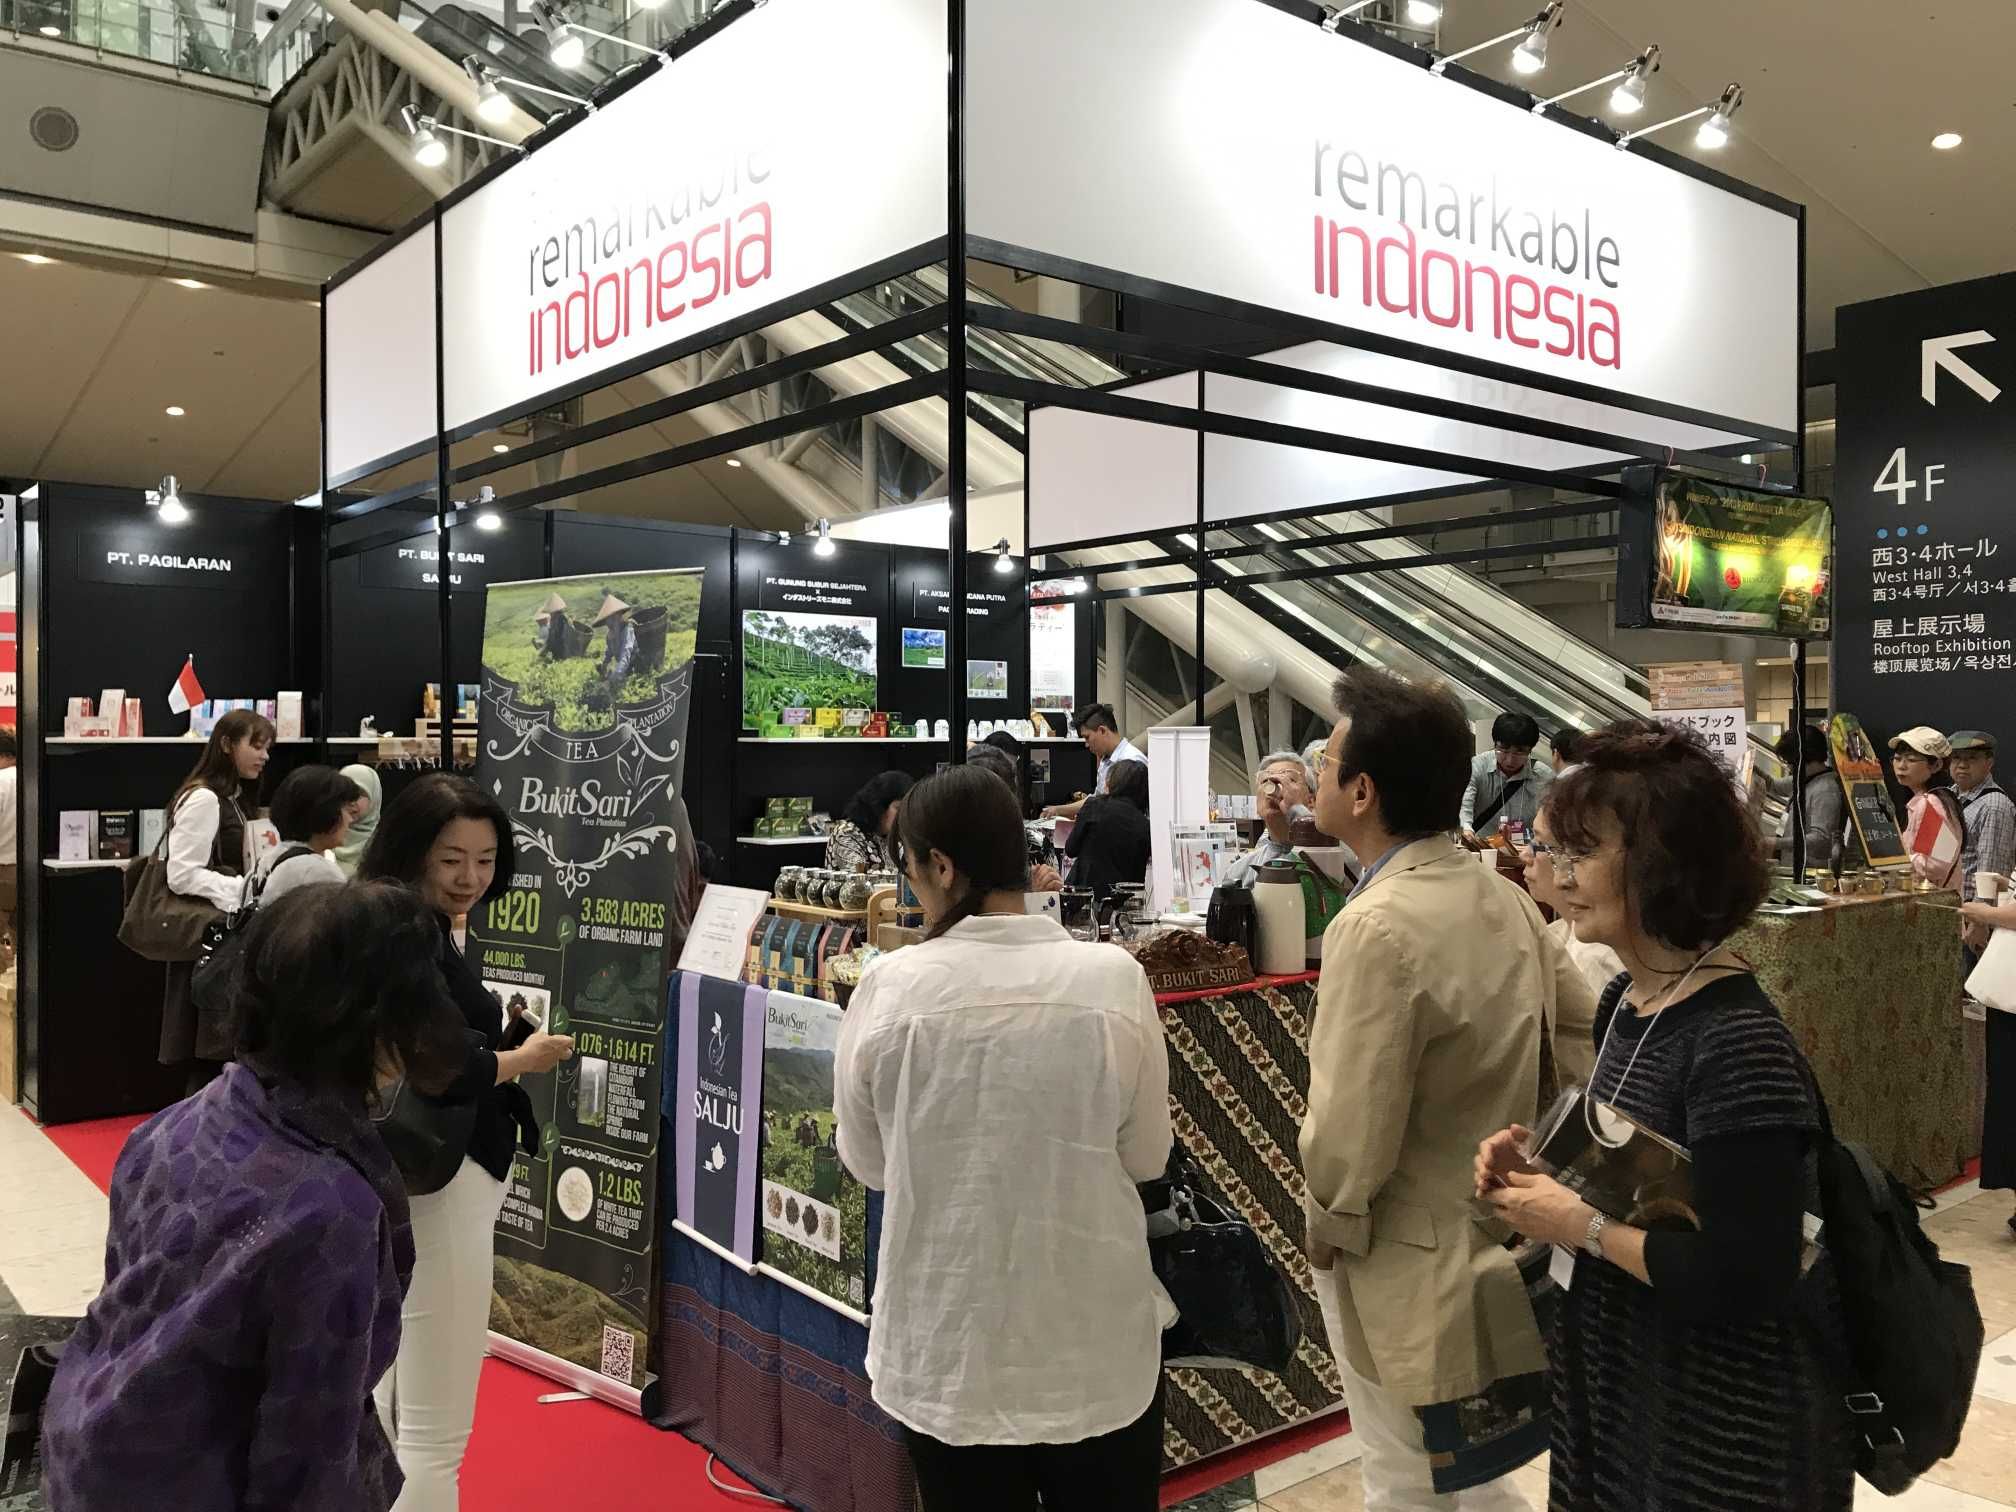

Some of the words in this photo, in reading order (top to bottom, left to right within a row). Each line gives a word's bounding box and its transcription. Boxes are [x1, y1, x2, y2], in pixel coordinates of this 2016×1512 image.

[1314, 139, 1620, 288] remarkable
[529, 201, 772, 376] indonesia
[1314, 214, 1620, 370] indonesia
[107, 551, 134, 566] PT.
[138, 553, 232, 571] PAGILARAN
[398, 548, 418, 560] PT.
[420, 550, 456, 562] BUT
[457, 552, 485, 564] SARI
[766, 577, 778, 585] PT.
[778, 578, 806, 588] GUNUNG
[830, 582, 867, 592] SEJAHTERA
[1873, 571, 1908, 583] West
[1914, 566, 1942, 580] Hall
[919, 589, 930, 598] PT.
[985, 594, 1006, 602] PUTRA
[1873, 613, 1986, 639] 屋上展示場
[1874, 642, 1930, 656] Rooftop
[1936, 637, 2011, 653] Exhibition
[566, 742, 599, 760] TEA
[534, 876, 542, 889] IN
[488, 890, 541, 935] 1920
[581, 897, 619, 925] 3,583
[620, 900, 666, 930] ACRES
[579, 924, 590, 939] OF
[591, 925, 620, 943] ORGANIC
[620, 928, 642, 945] FARM
[643, 931, 664, 948] LAND
[510, 953, 527, 969] LBS.
[482, 967, 495, 978] TEAS
[496, 968, 523, 983] PRODUCED
[1162, 970, 1205, 988] BUKIT
[1209, 967, 1240, 984] SARI
[639, 1042, 656, 1066] FT.
[700, 1076, 728, 1099] Indonesian
[728, 1086, 738, 1102] Tea
[694, 1090, 744, 1135] SALJU
[620, 1128, 632, 1141] OUR
[632, 1130, 649, 1144] FARM
[616, 1176, 645, 1206] LBS.
[612, 1214, 640, 1231] PRODUCED
[618, 1204, 629, 1216] TEA
[629, 1207, 643, 1221] THAT
